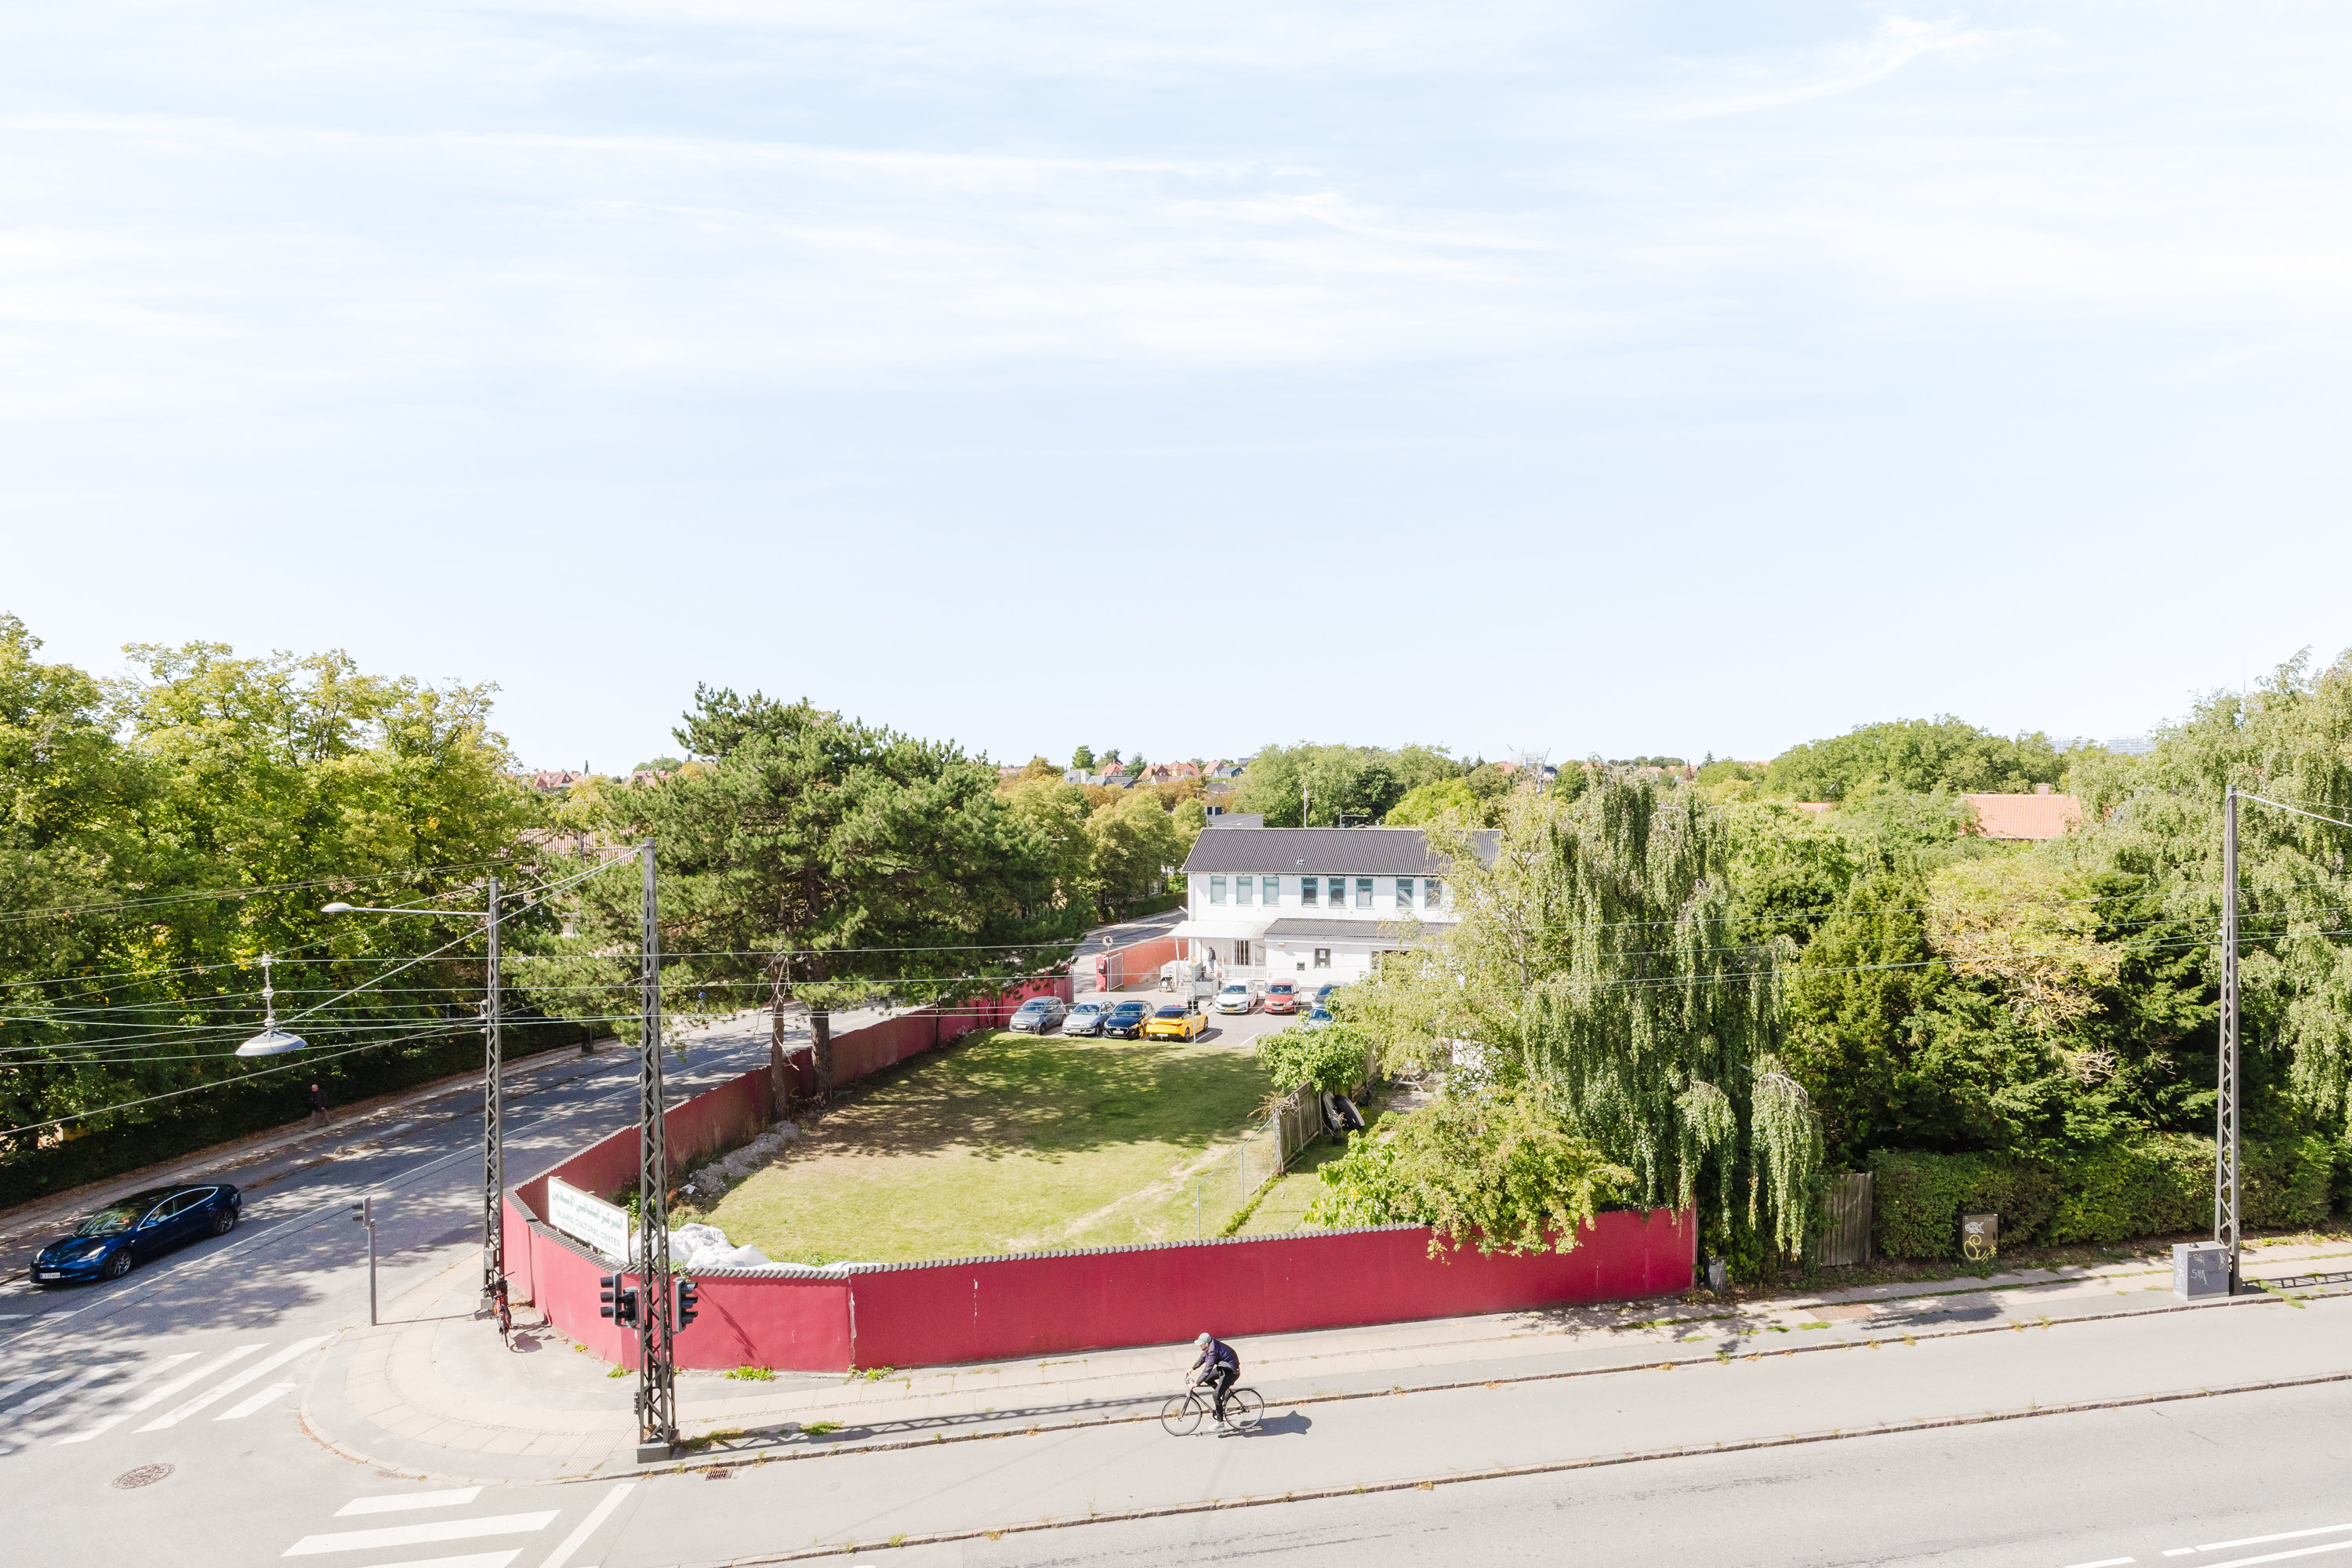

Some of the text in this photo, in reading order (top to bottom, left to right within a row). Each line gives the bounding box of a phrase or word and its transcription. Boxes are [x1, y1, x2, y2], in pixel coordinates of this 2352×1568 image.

[556, 1209, 574, 1224] ISLAMIC
[575, 1218, 599, 1236] CULTURAL
[600, 1231, 621, 1248] CENTER
